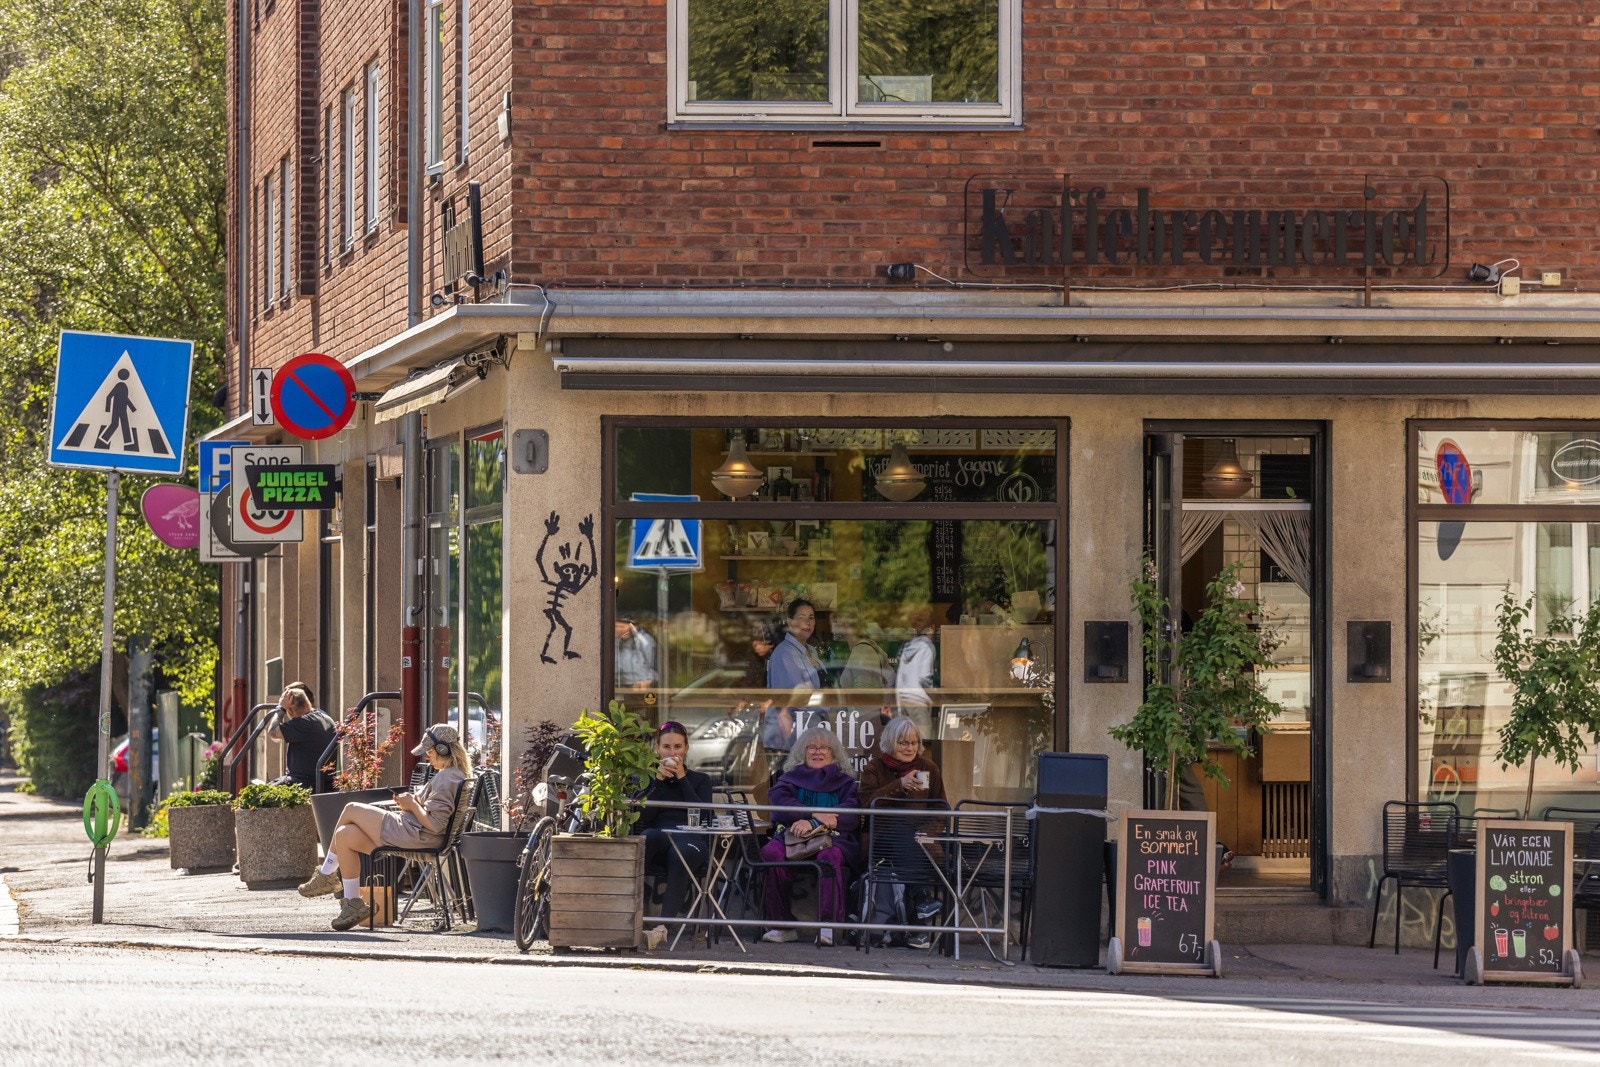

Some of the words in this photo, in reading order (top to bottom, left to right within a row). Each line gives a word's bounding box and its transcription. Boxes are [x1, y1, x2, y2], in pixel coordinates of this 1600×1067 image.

[981, 187, 1436, 267] Kaffebrenneriet
[257, 471, 329, 487] JUNGEL
[263, 487, 322, 502] PIZZA
[1135, 824, 1151, 839] En
[1156, 825, 1182, 840] smak
[1185, 830, 1197, 840] av
[1522, 836, 1550, 848] EGEN
[1491, 850, 1553, 867] LIMONADE
[1147, 860, 1177, 875] PINK
[1134, 874, 1200, 895] GRAPEFRUIT
[1509, 870, 1544, 885] sitron
[1519, 886, 1536, 894] eller
[1143, 894, 1161, 910] ICE
[1166, 896, 1188, 912] TEA
[1509, 911, 1520, 924] og
[1521, 908, 1550, 921] sitron
